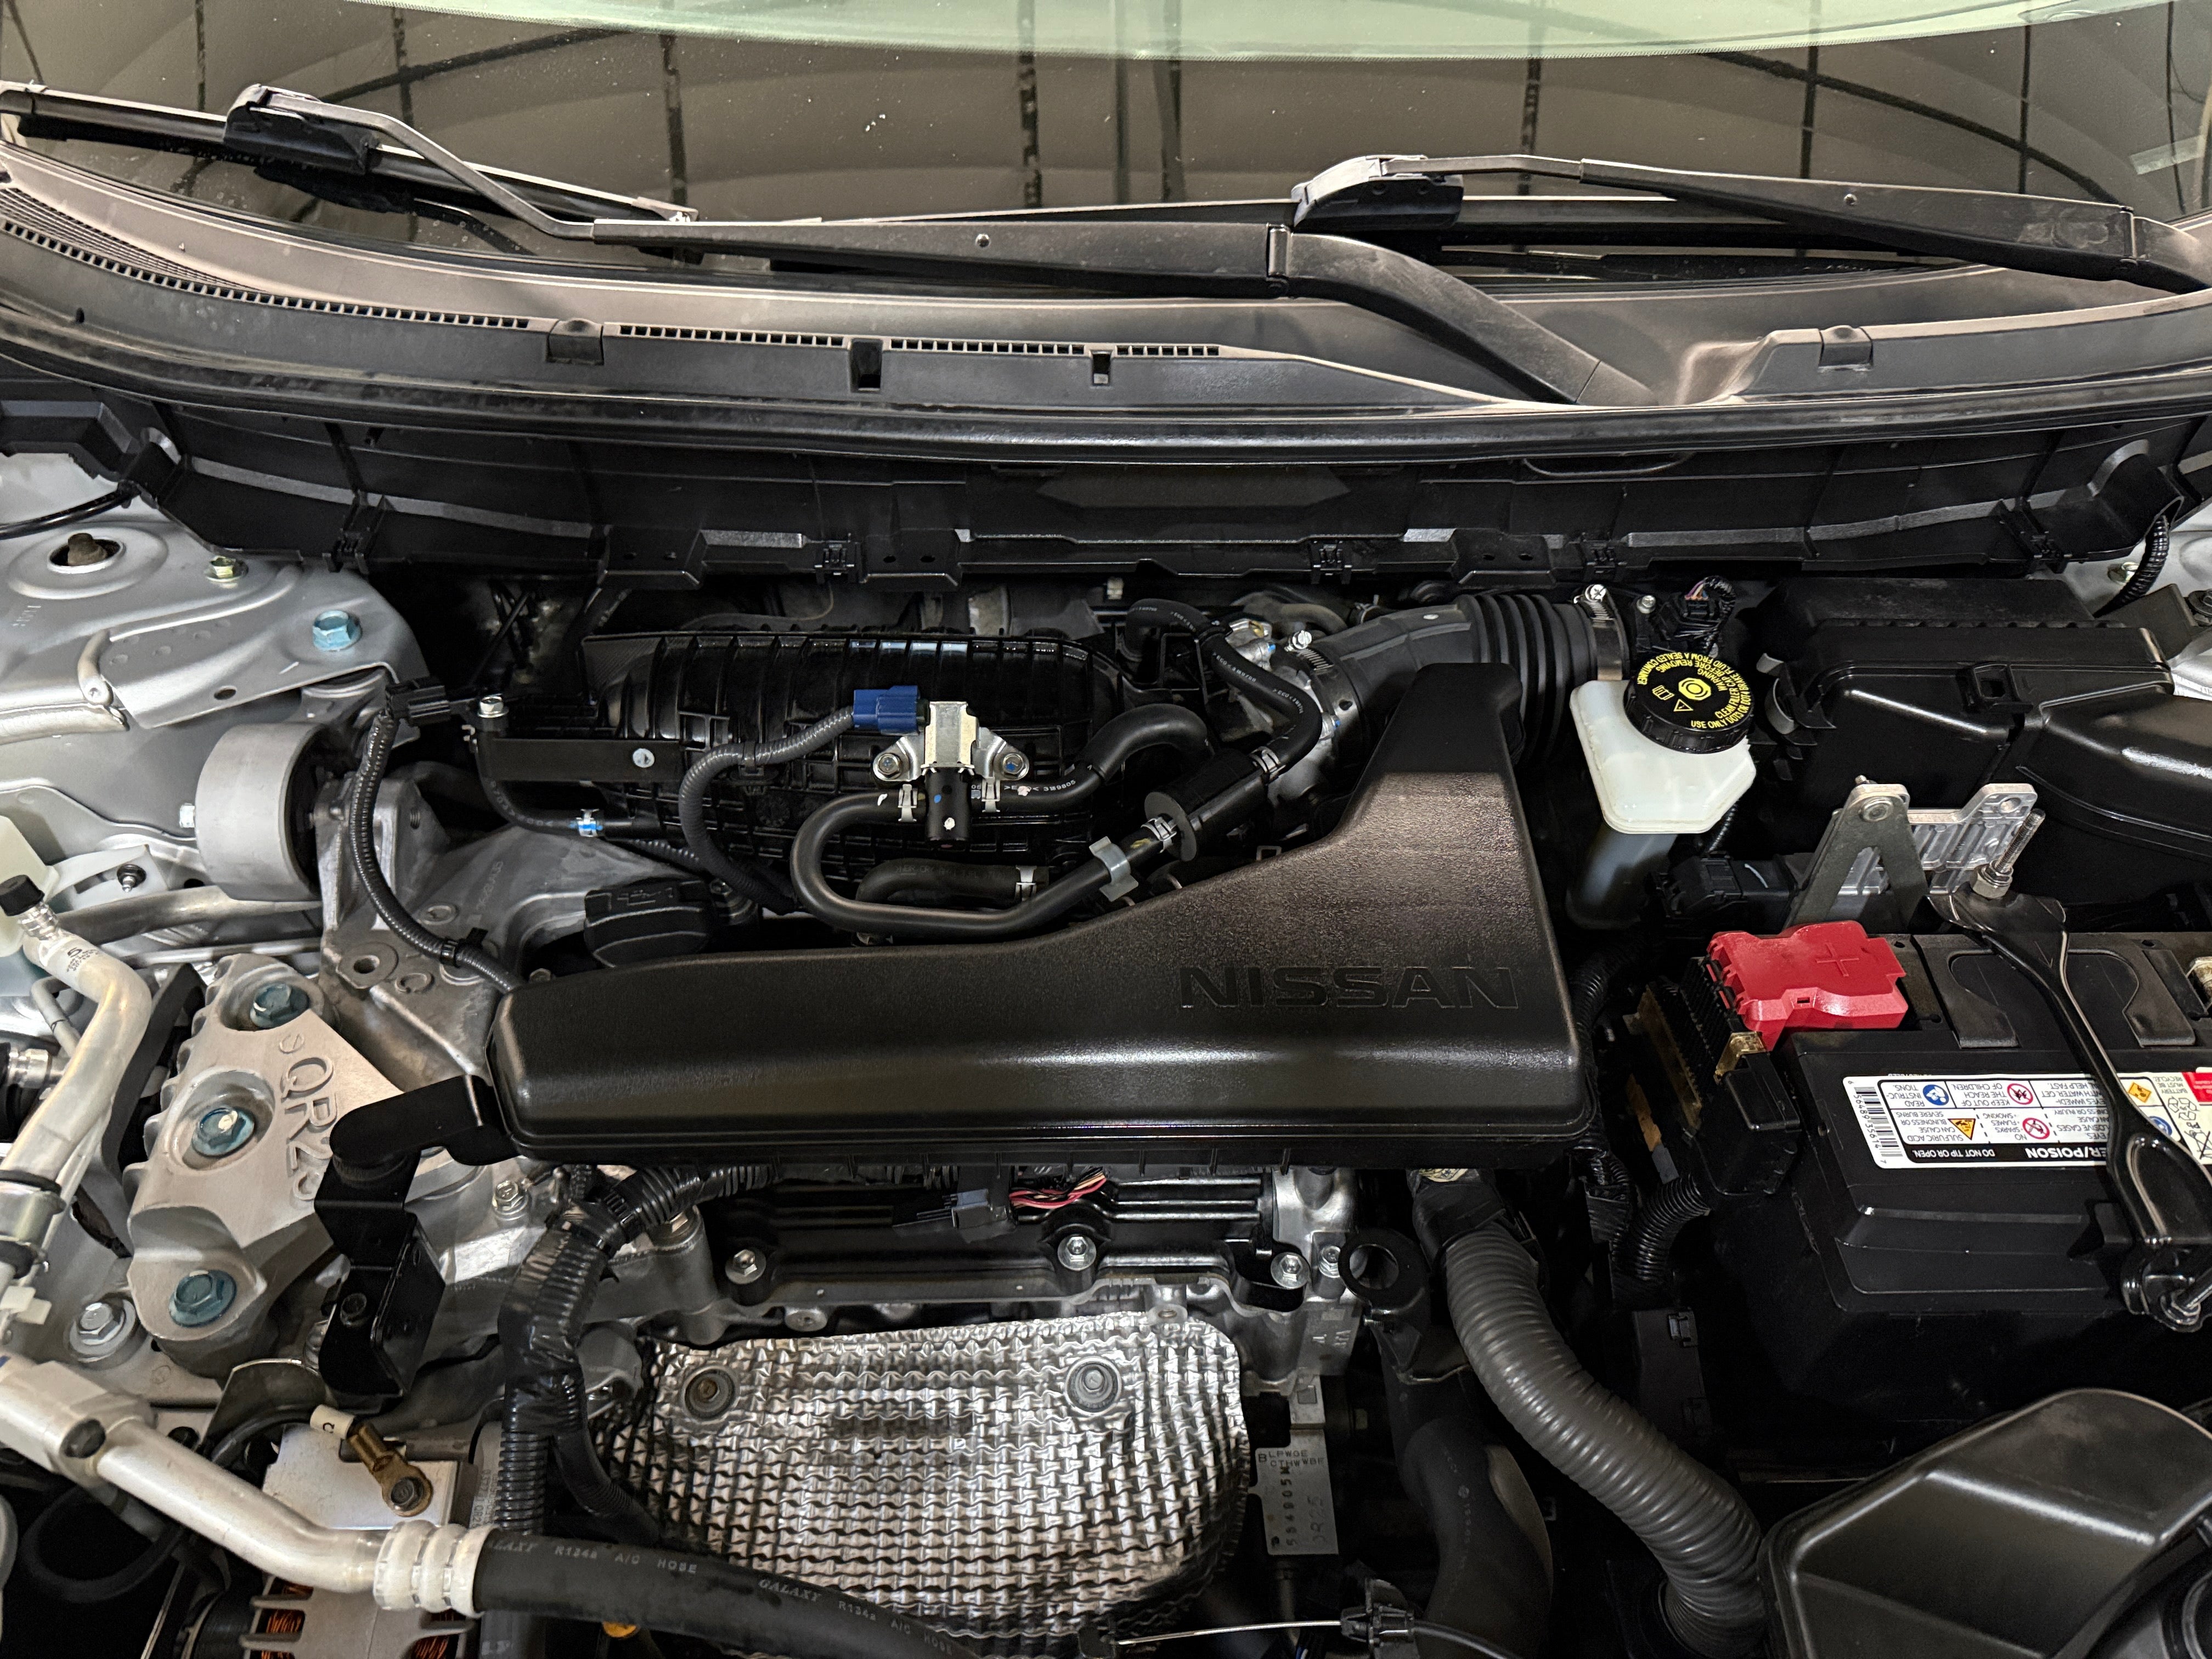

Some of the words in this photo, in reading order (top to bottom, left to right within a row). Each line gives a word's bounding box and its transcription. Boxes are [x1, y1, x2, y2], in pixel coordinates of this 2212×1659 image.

[1656, 652, 1683, 662] SEALED
[1691, 653, 1713, 664] FROM
[1637, 659, 1658, 685] CONTAINER
[1656, 659, 1692, 673] REMOVING
[1695, 663, 1724, 676] BEFORE
[1713, 661, 1735, 674] FLUID
[1698, 668, 1728, 691] WARNING
[1721, 676, 1736, 687] CAP
[1731, 673, 1749, 691] BRAKE
[1729, 687, 1740, 707] FILLER
[1715, 703, 1736, 719] CLEAN
[1724, 713, 1744, 723] DOT3
[1708, 719, 1728, 728] ONLY
[1180, 966, 1519, 1009] NISSAN
[1853, 1094, 1870, 1119] 56489
[1865, 1123, 1881, 1149] 35614
[657, 1559, 698, 1575] HOSE
